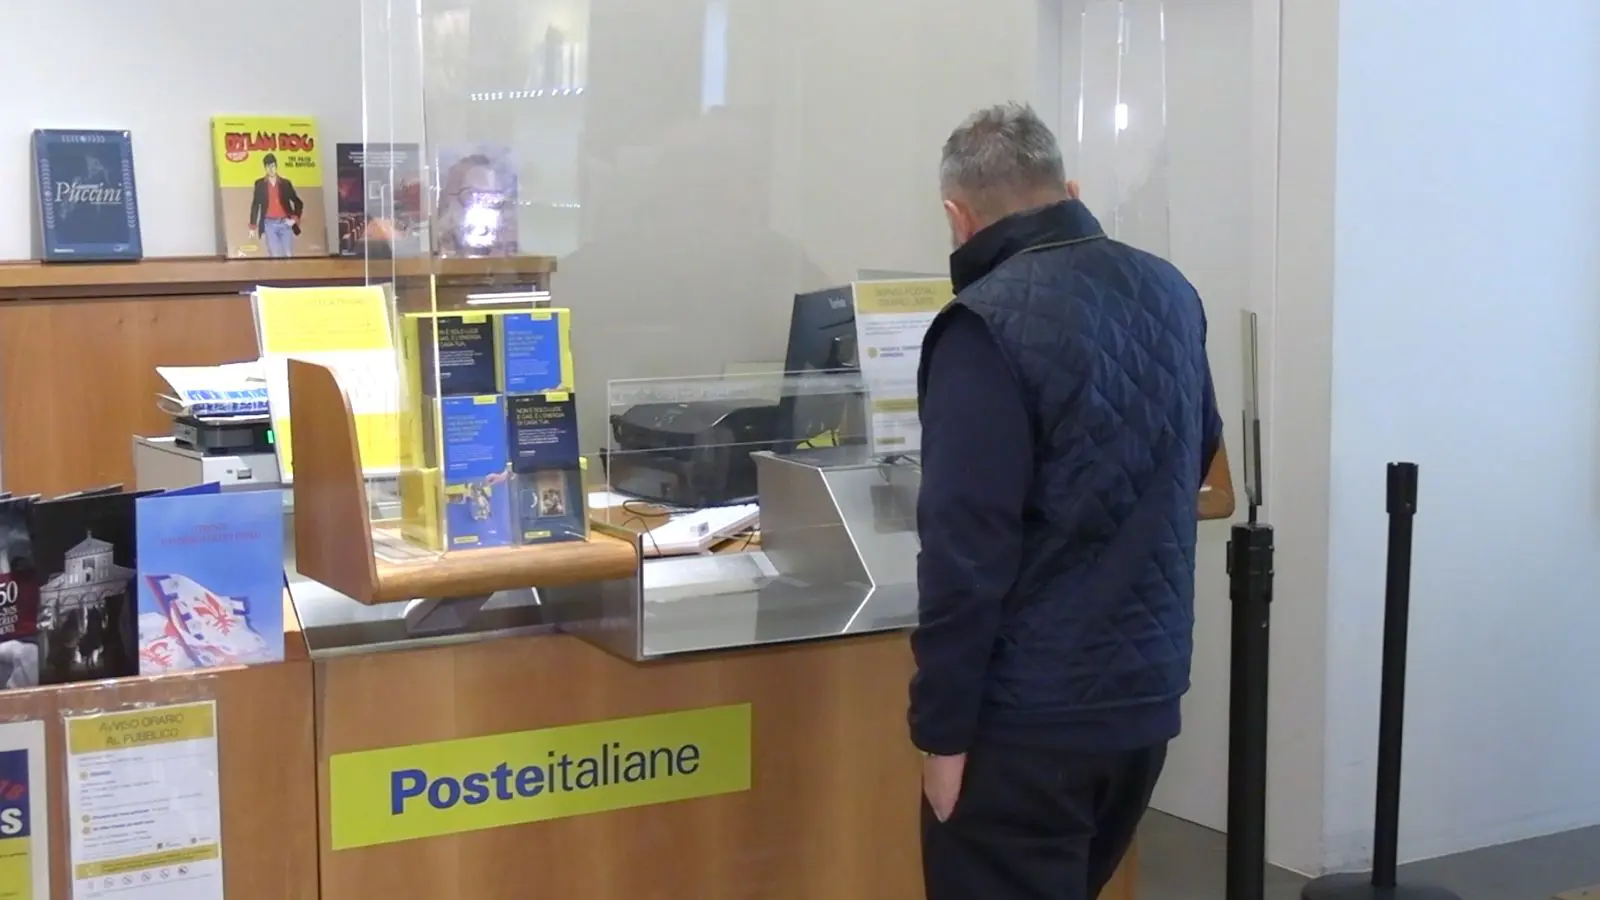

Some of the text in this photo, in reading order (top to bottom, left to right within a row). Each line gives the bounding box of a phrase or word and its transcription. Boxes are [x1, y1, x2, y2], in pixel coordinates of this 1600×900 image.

[278, 132, 314, 152] DOG
[54, 181, 122, 203] Puccini
[99, 712, 185, 732] AVVISO ORARIO
[105, 727, 179, 746] AL PUBBLICO
[390, 742, 700, 816] Posteitaliane
